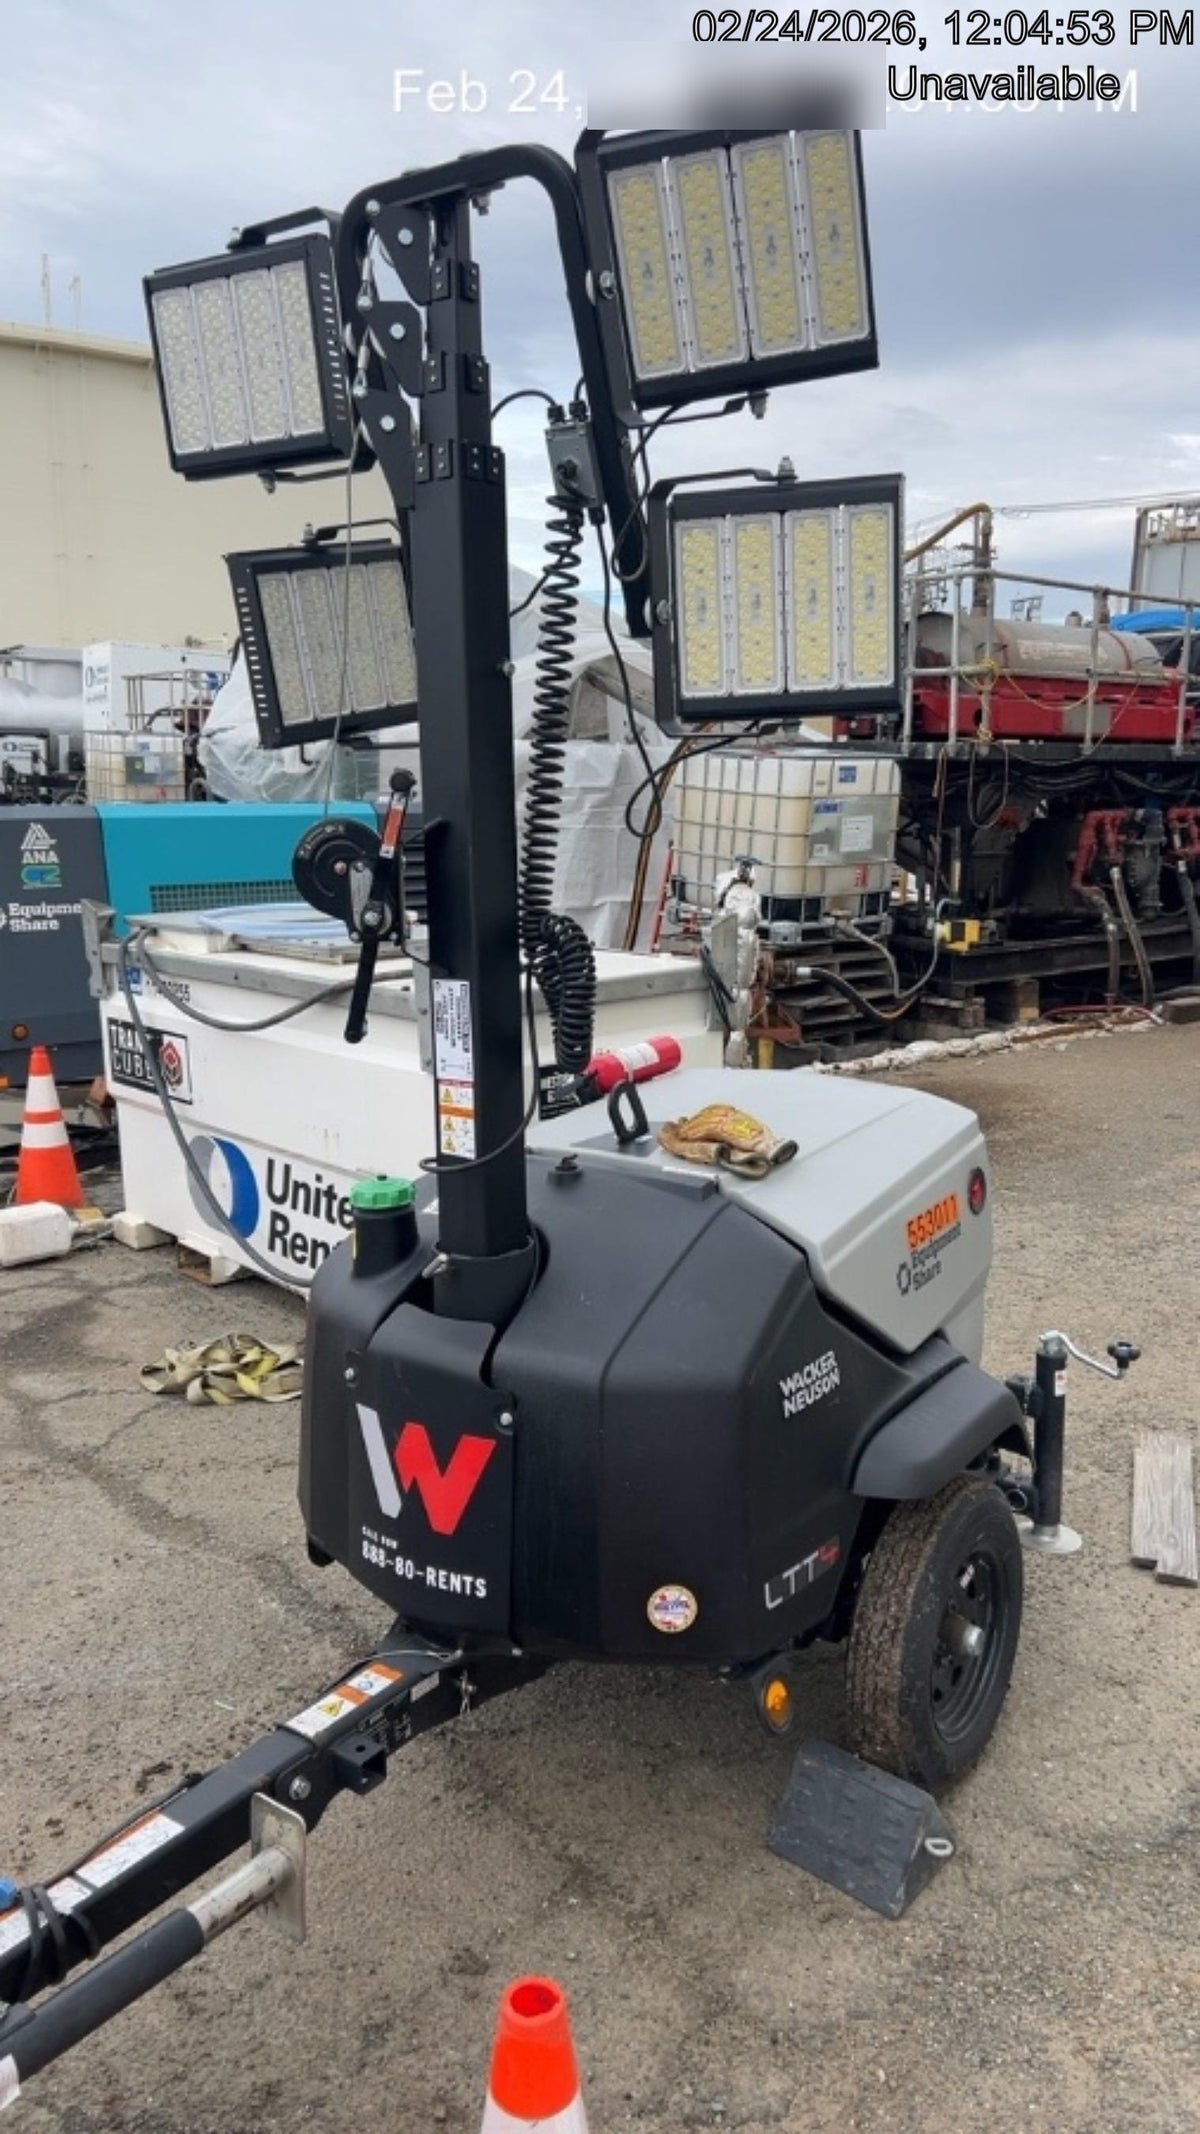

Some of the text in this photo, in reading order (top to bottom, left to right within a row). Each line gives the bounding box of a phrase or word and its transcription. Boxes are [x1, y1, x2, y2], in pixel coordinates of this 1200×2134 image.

[22, 850, 61, 865] ANA
[8, 902, 82, 919] Equipme
[9, 918, 60, 933] Share
[267, 1157, 355, 1231] Unite
[907, 1194, 957, 1249] 553011
[913, 1260, 942, 1291] Share
[779, 1350, 838, 1398] WACKER
[783, 1367, 840, 1419] NEUSON
[362, 1540, 487, 1598] 888-80-RENTS
